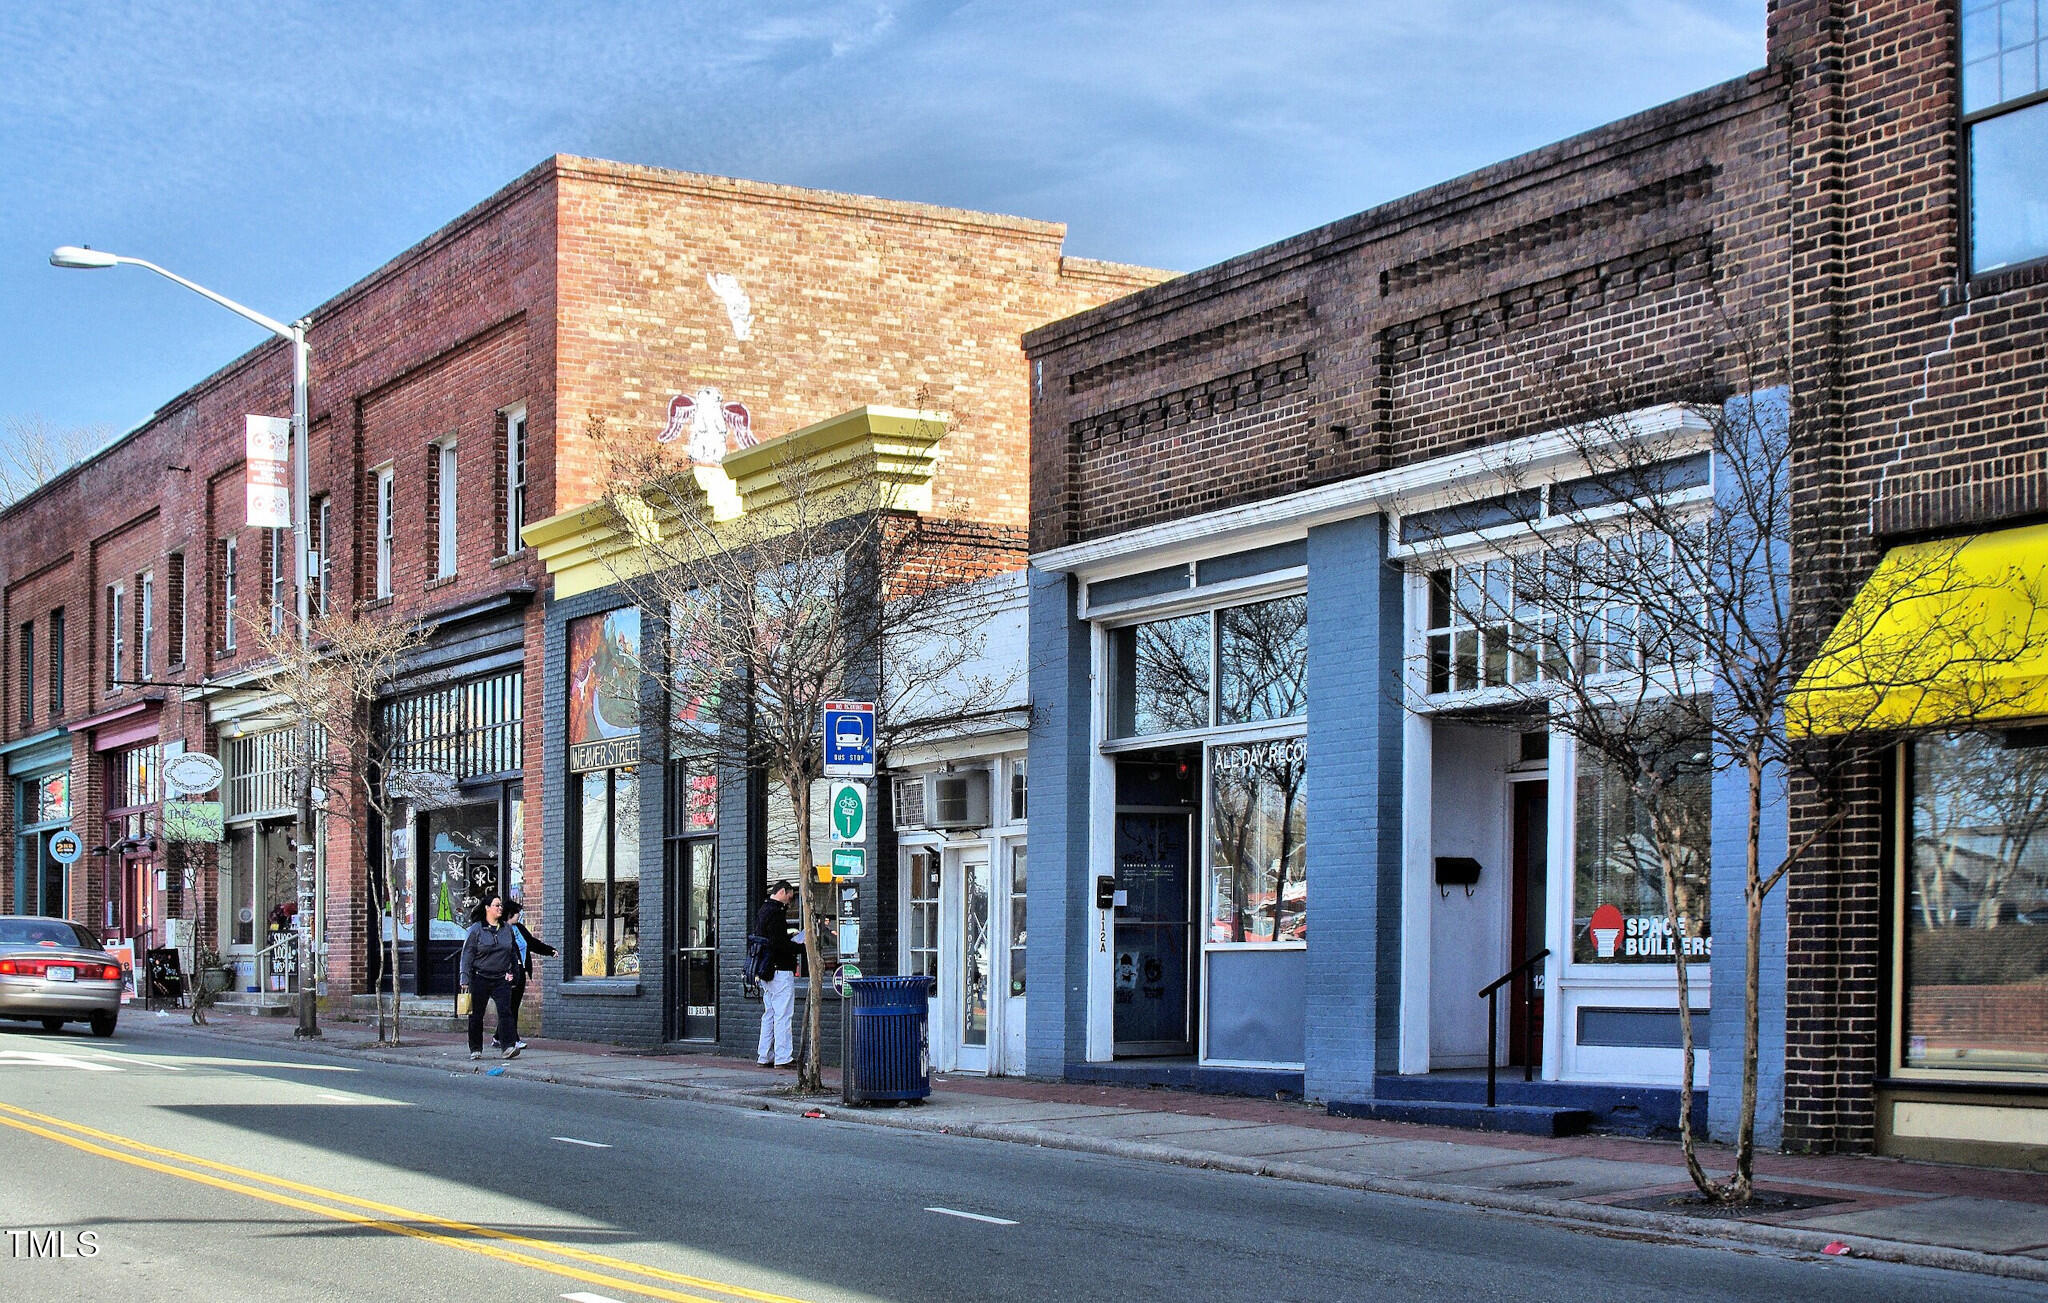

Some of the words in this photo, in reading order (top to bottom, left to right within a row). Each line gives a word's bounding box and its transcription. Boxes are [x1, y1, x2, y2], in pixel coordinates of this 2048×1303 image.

[572, 745, 607, 770] WEAVER
[608, 740, 641, 765] STREET
[1214, 750, 1240, 770] ALL
[1241, 746, 1266, 767] DAY
[845, 815, 851, 836] 1
[56, 843, 74, 853] 2ND
[1099, 910, 1107, 953] 112A
[1626, 917, 1687, 937] SPACE
[1625, 937, 1712, 956] BUILDERS
